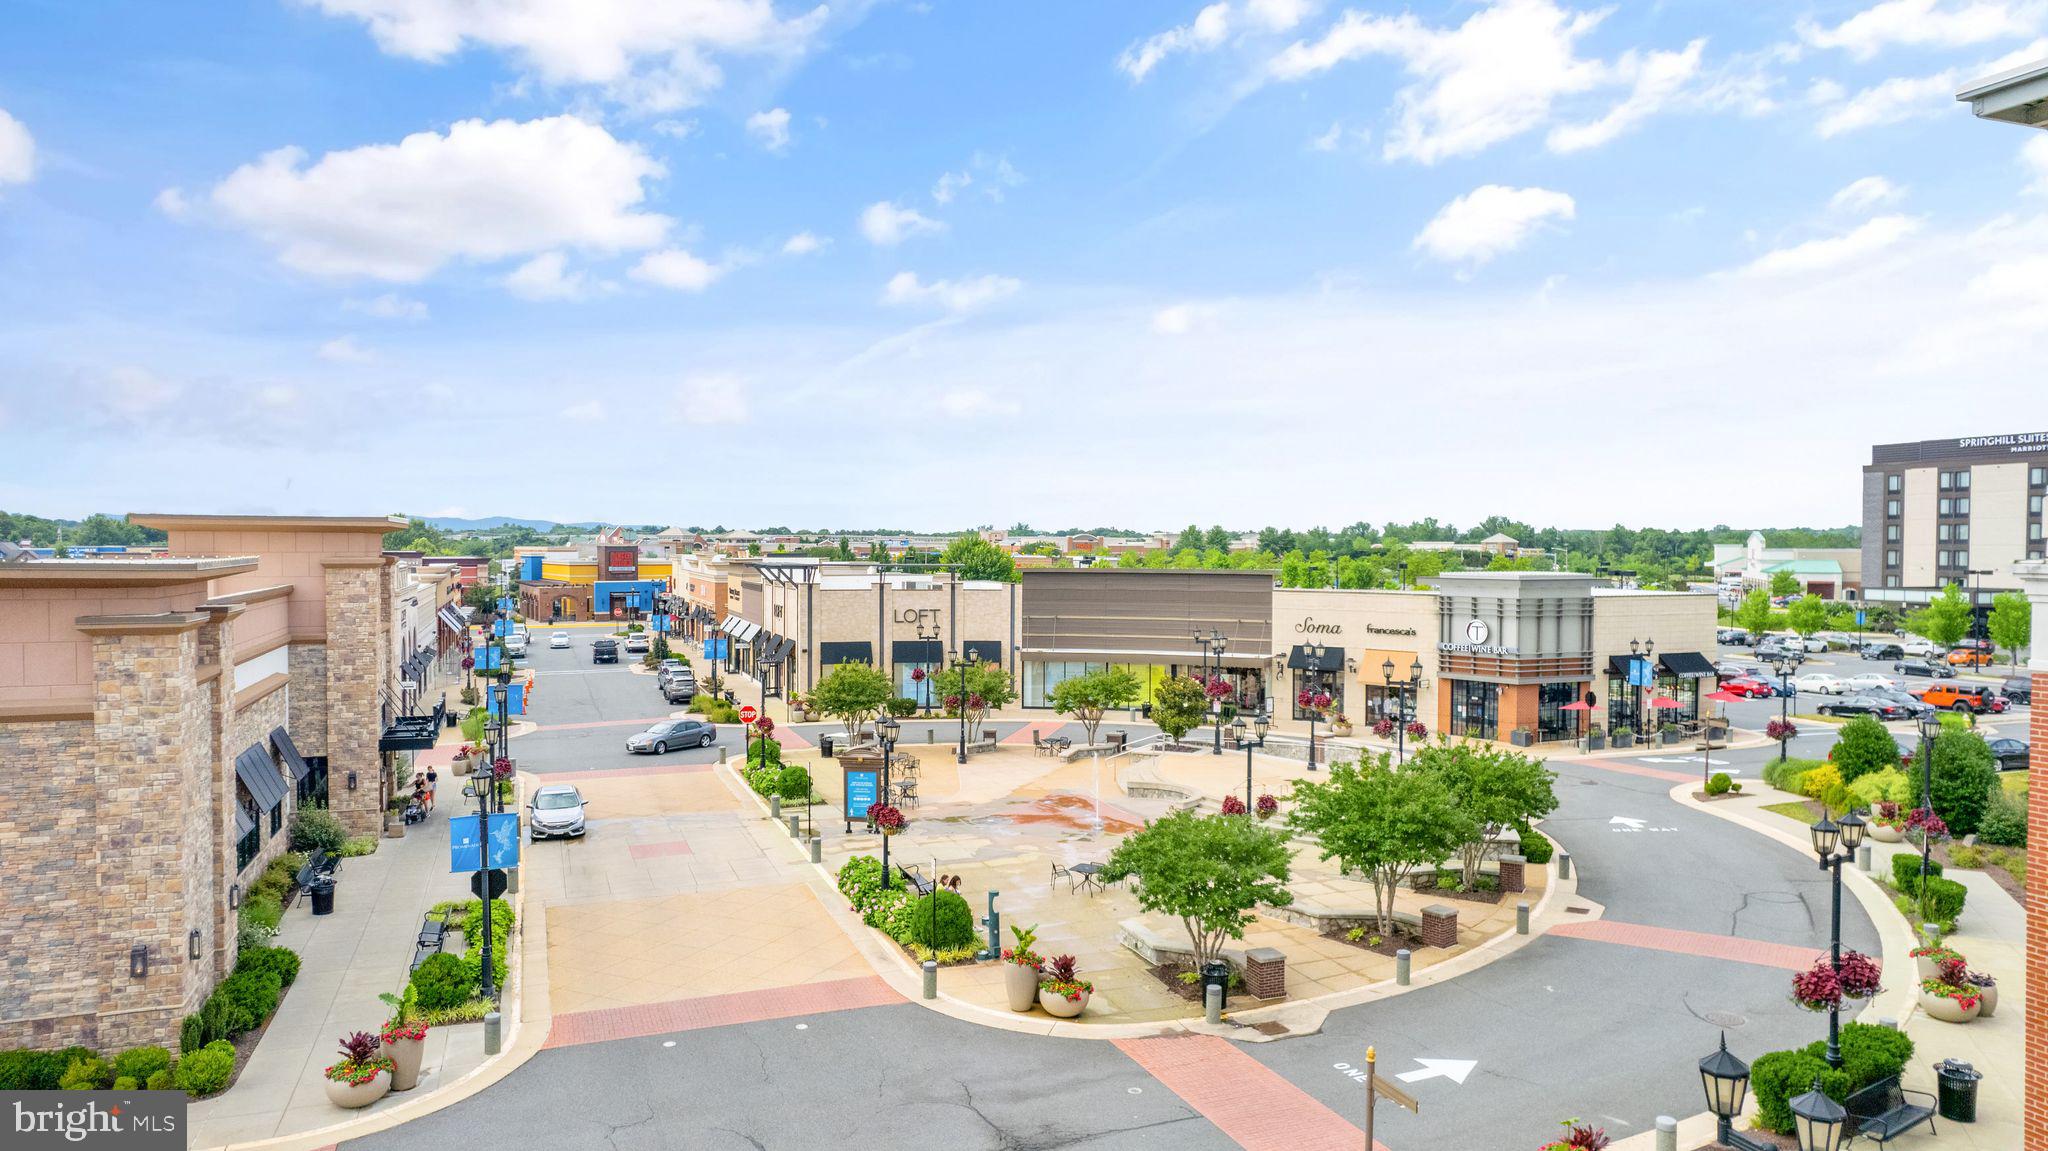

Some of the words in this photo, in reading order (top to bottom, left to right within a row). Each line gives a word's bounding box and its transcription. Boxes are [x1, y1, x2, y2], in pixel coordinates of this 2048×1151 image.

[1960, 435, 2016, 448] SPRINGHILL
[894, 609, 941, 623] LOFT
[1295, 616, 1342, 635] Soma
[1366, 623, 1417, 636] francesca's
[1493, 646, 1508, 654] BAR
[1333, 1062, 1368, 1083] ONE
